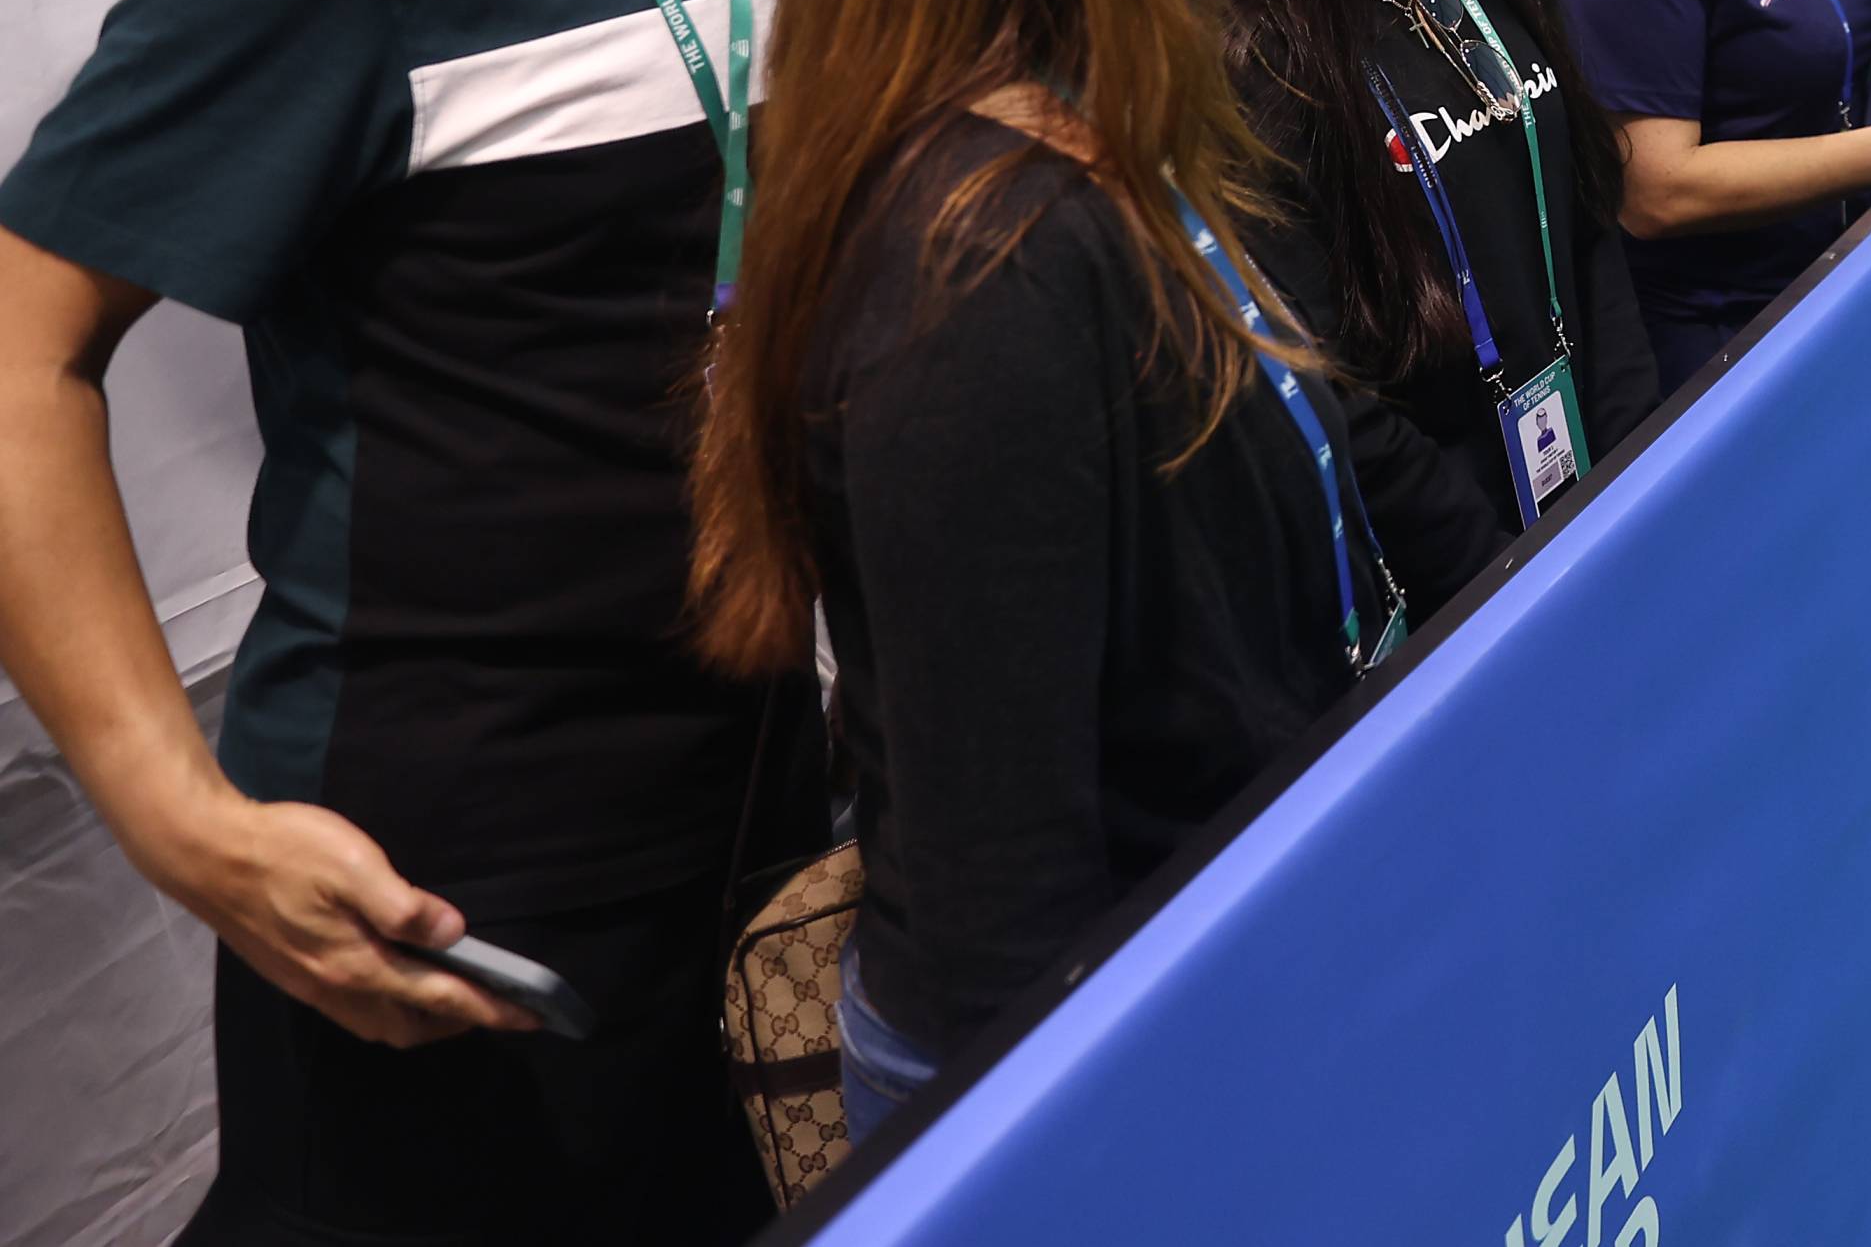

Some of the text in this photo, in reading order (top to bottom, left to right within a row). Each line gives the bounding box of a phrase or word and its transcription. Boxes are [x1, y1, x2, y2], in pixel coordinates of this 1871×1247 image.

[1480, 20, 1492, 35] OF
[681, 39, 705, 74] THE
[1521, 103, 1532, 129] THE
[1514, 371, 1556, 407] THE WORLD CUP
[1522, 385, 1551, 411] OF TENNIS
[1505, 981, 1682, 1247] EAN
